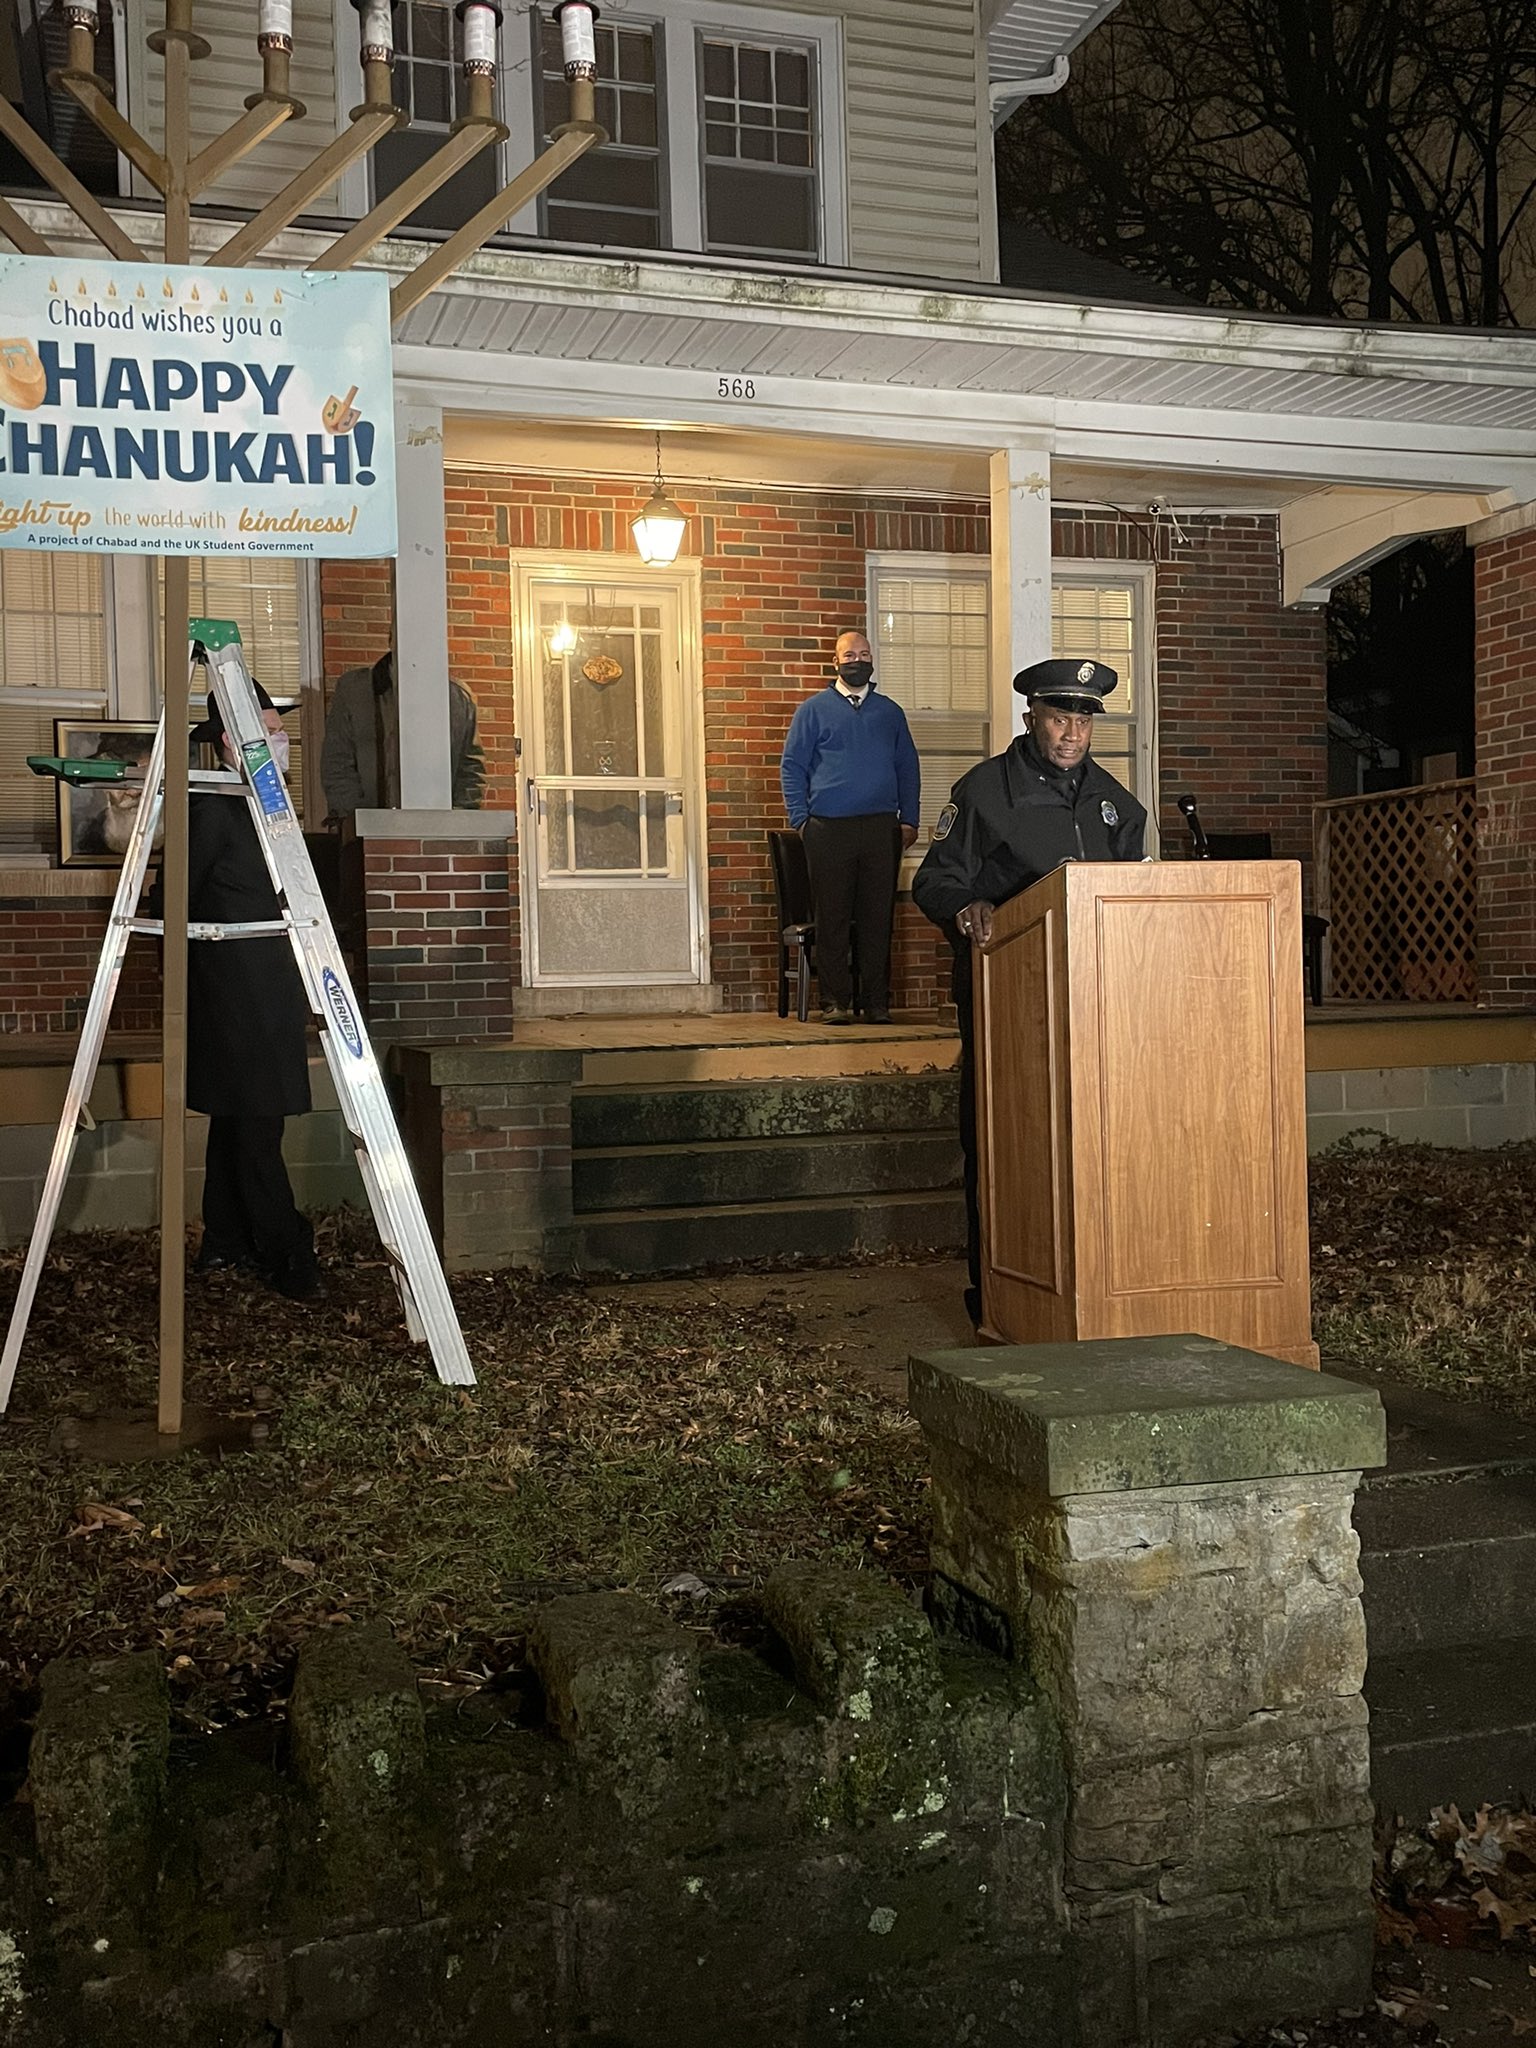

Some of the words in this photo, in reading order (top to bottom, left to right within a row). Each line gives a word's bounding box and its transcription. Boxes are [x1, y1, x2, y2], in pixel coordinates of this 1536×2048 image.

[48, 298, 135, 330] Chabad
[141, 305, 216, 334] wishes
[222, 315, 262, 344] you
[269, 318, 283, 337] a
[37, 339, 296, 416] HAPPY
[717, 377, 756, 399] 568
[0, 408, 376, 487] HANUKAH!
[0, 499, 73, 533] ght
[57, 509, 92, 536] up
[105, 506, 131, 527] the
[136, 508, 184, 529] world
[189, 509, 227, 530] with
[237, 504, 359, 536] kindness!
[27, 533, 37, 543] A
[39, 534, 79, 546] project
[82, 535, 94, 546] of
[96, 536, 138, 547] Chabad
[140, 538, 161, 549] and
[164, 539, 182, 550] the
[185, 540, 201, 550] UK
[203, 540, 246, 551] Student
[248, 541, 314, 552] Government
[329, 985, 358, 1041] WERNER
